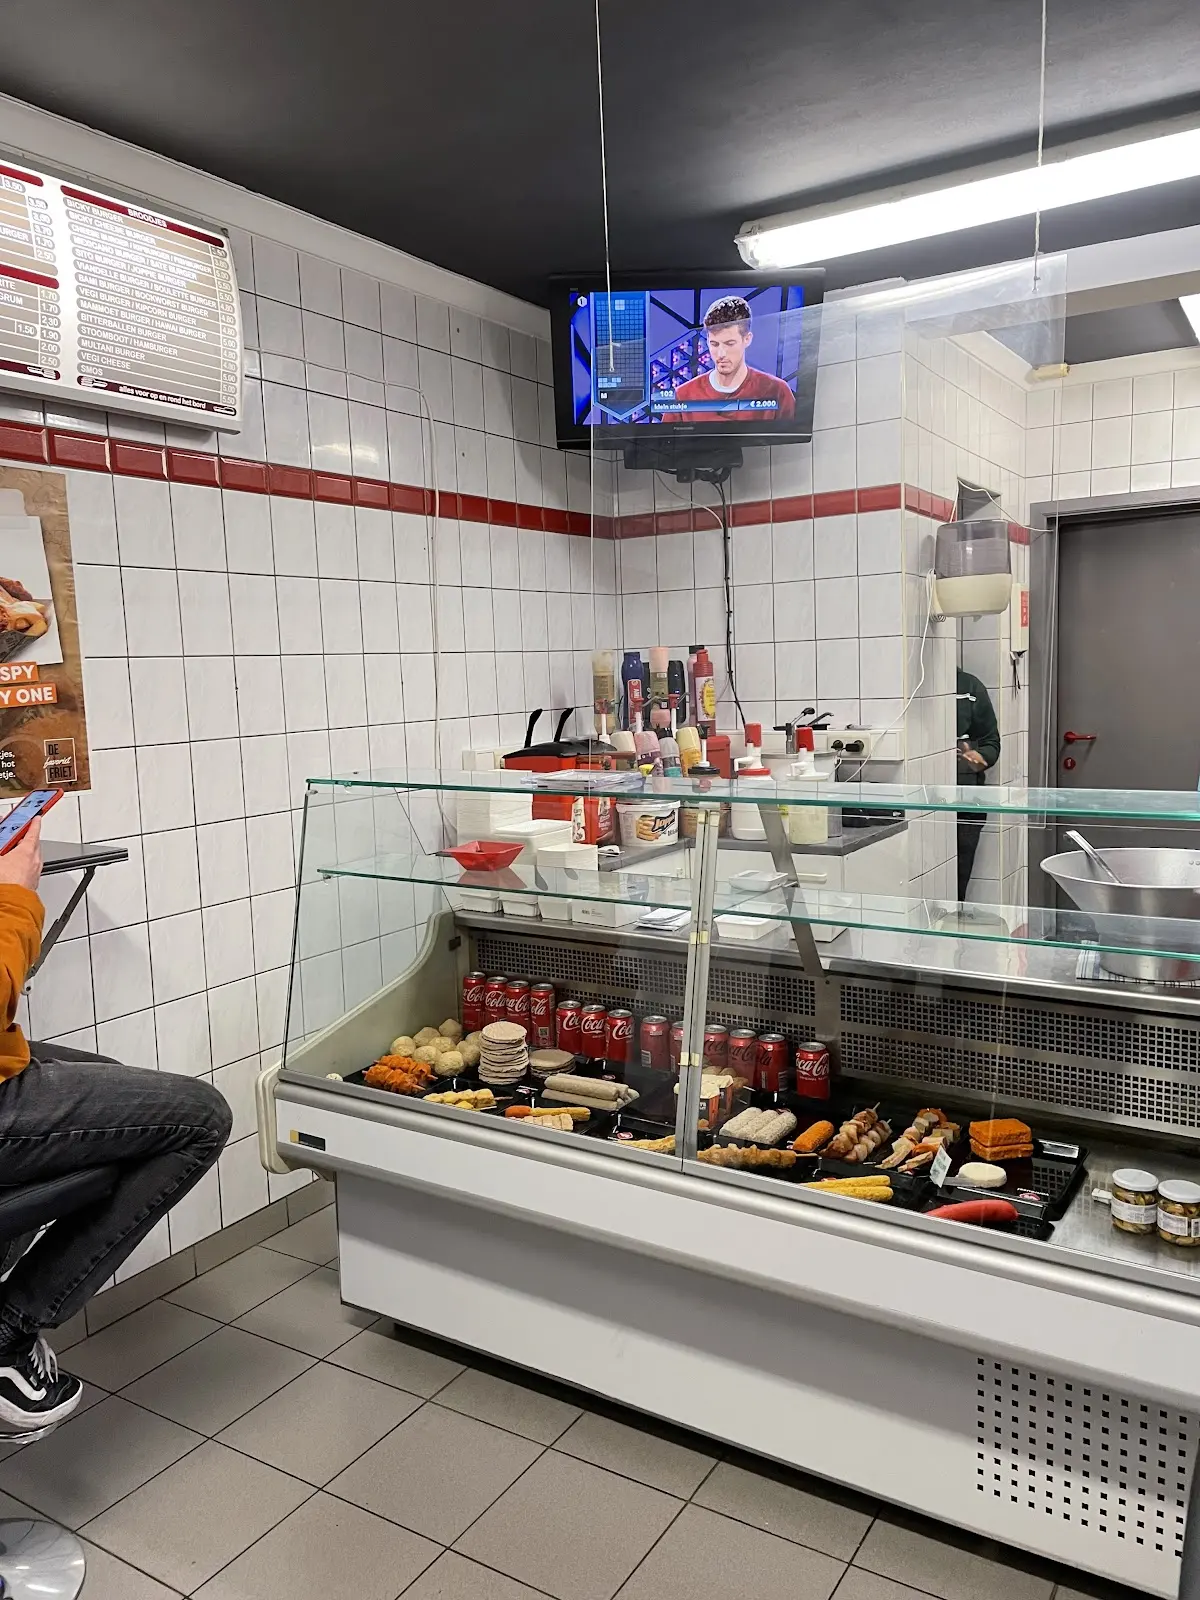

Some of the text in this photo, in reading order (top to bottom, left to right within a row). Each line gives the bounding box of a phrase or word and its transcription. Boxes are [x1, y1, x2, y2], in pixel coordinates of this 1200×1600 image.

[66, 199, 91, 213] BICKY
[91, 207, 124, 224] BURGER
[127, 208, 168, 228] BROODJES
[37, 249, 53, 261] 2.50
[120, 273, 149, 288] BURGER
[154, 283, 189, 300] BOULETTE
[41, 289, 57, 301] 1.70
[78, 273, 98, 286] BAMI
[99, 280, 130, 295] BURGER
[135, 289, 180, 308] BOCKWORST
[181, 303, 209, 318] BURGER
[219, 292, 233, 302] 5.50
[41, 303, 58, 314] 1.70
[80, 286, 98, 299] VEGI
[100, 293, 131, 307] BURGER
[135, 301, 167, 317] KIPCORN
[169, 311, 197, 326] BURGER
[41, 316, 58, 327] 2.30
[80, 300, 119, 317] MAMMOET
[120, 310, 150, 326] BURGER
[155, 320, 178, 333] HAWAI
[179, 326, 207, 340] BURGER
[80, 313, 136, 333] BITTERBALLEN
[137, 327, 167, 342] BURGER
[42, 329, 58, 340] 1.90
[81, 325, 129, 343] STOOMBOOT
[133, 338, 178, 356] HAMBURGER
[41, 343, 57, 354] 2.00
[81, 339, 114, 354] MULTANI
[115, 347, 146, 361] BURGER
[41, 356, 57, 367] 2.50
[81, 351, 99, 363] VEGI
[100, 356, 131, 370] CHEESE
[80, 364, 103, 376] SMOS
[119, 385, 134, 394] alles
[135, 389, 150, 398] voor
[168, 396, 181, 404] rond
[182, 398, 192, 406] het
[192, 400, 206, 409] bord
[659, 390, 674, 398] 102
[756, 400, 776, 408] 2.000
[0, 664, 35, 681] SPY
[16, 686, 54, 703] ONE
[48, 743, 59, 755] DE
[1, 760, 16, 768] hot
[50, 765, 72, 778] FRIET
